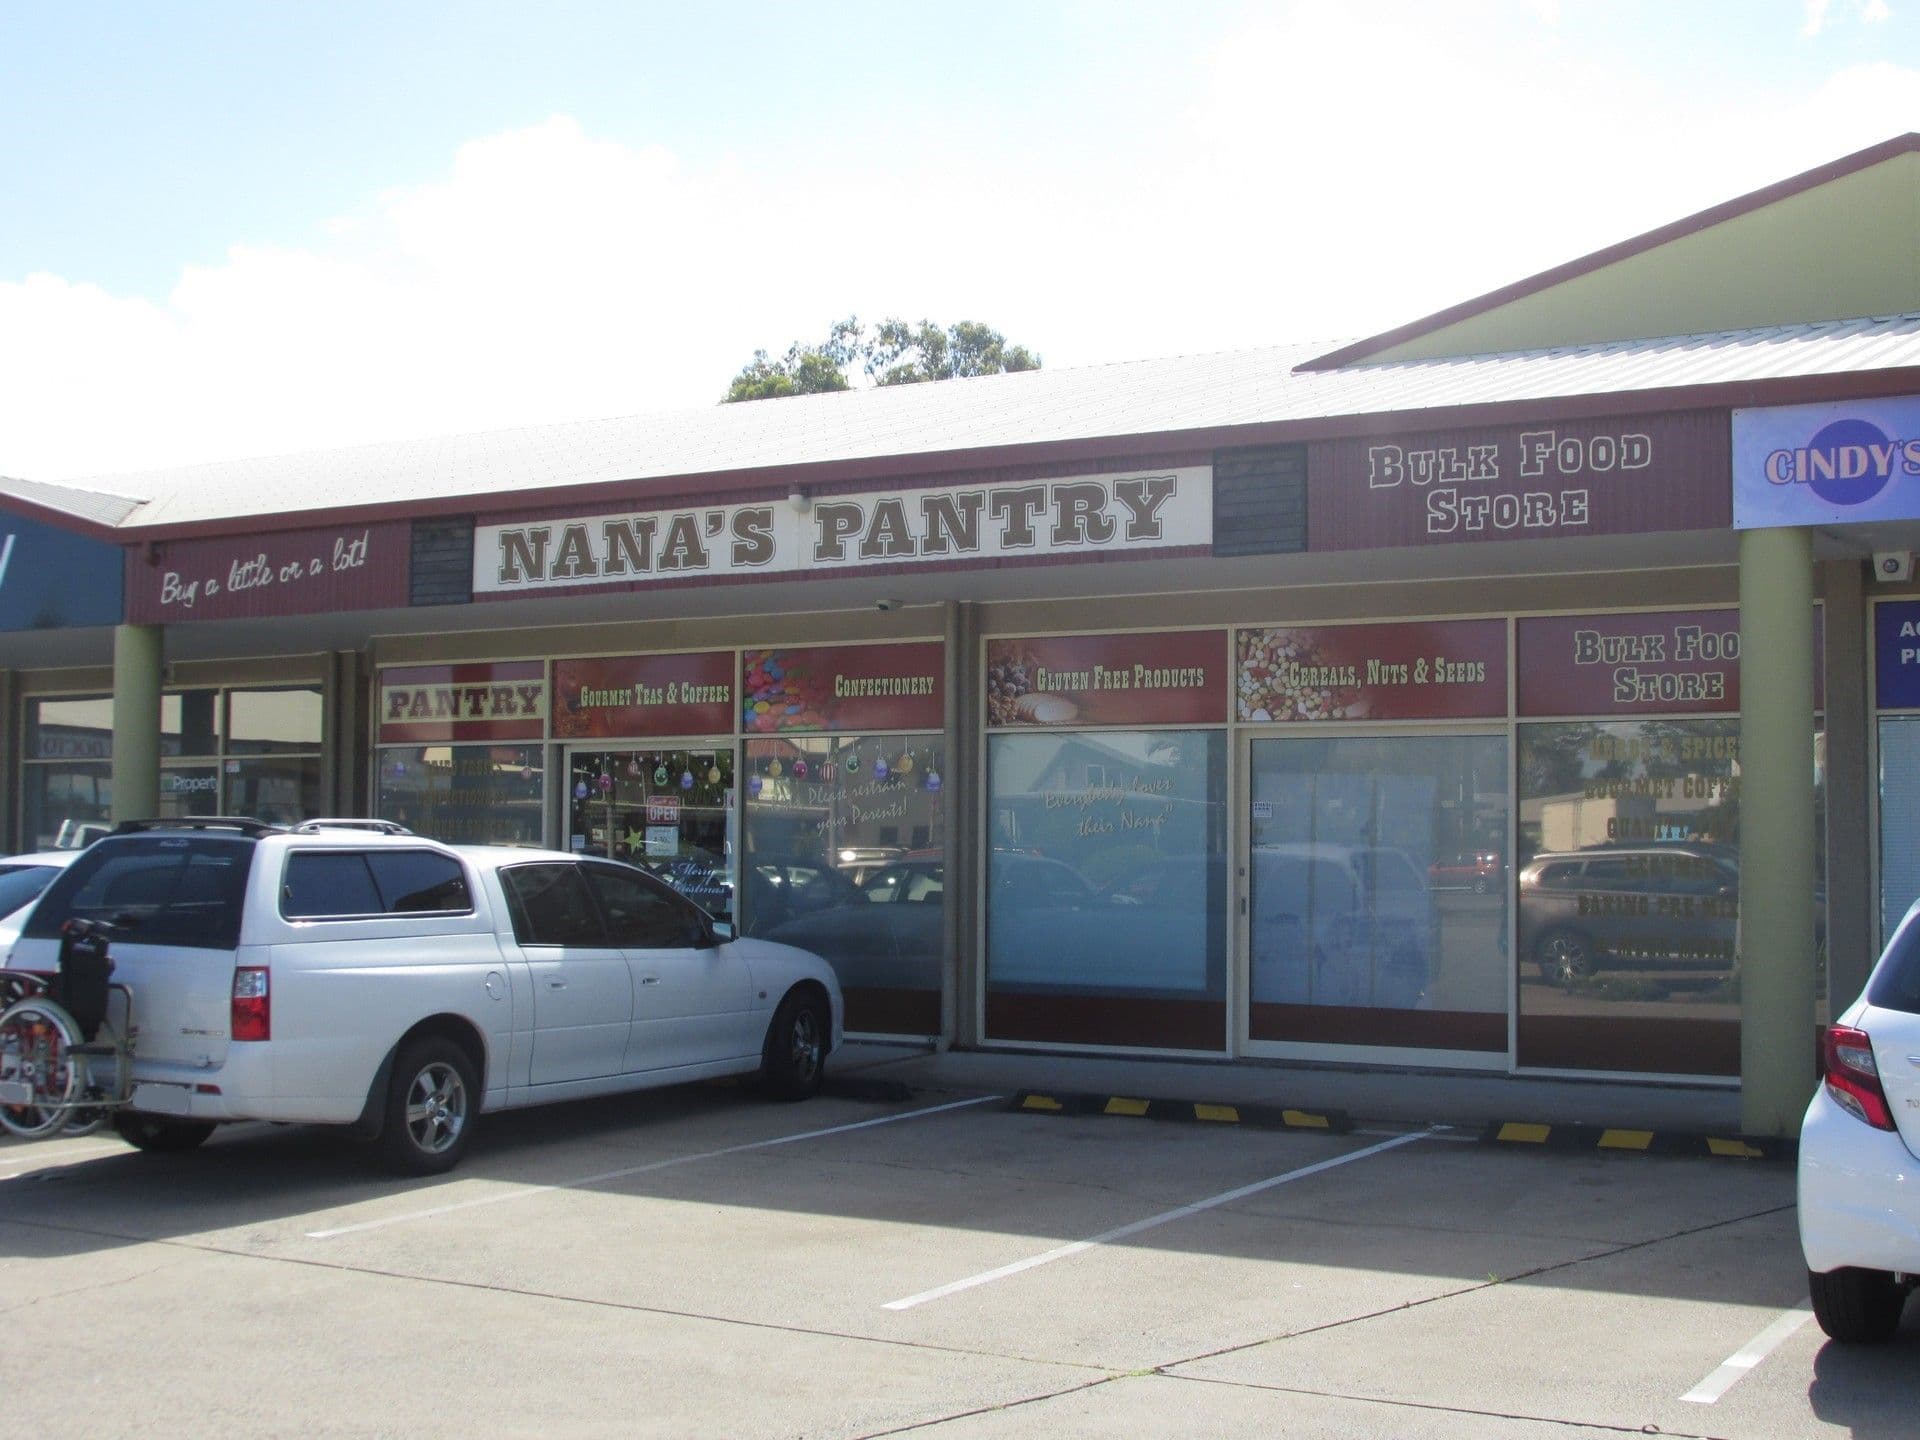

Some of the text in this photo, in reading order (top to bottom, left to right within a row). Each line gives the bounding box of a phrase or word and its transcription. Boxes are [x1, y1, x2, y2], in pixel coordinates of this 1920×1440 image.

[1764, 438, 1920, 486] CINDY'S
[498, 475, 1177, 584] NANA'S PANTRY
[161, 530, 369, 608] Buy a little or a lot!
[1675, 626, 1740, 661] FOO
[1413, 657, 1429, 684] &
[388, 686, 543, 718] PANTRY
[667, 682, 678, 704] &
[650, 806, 677, 821] OPEN
